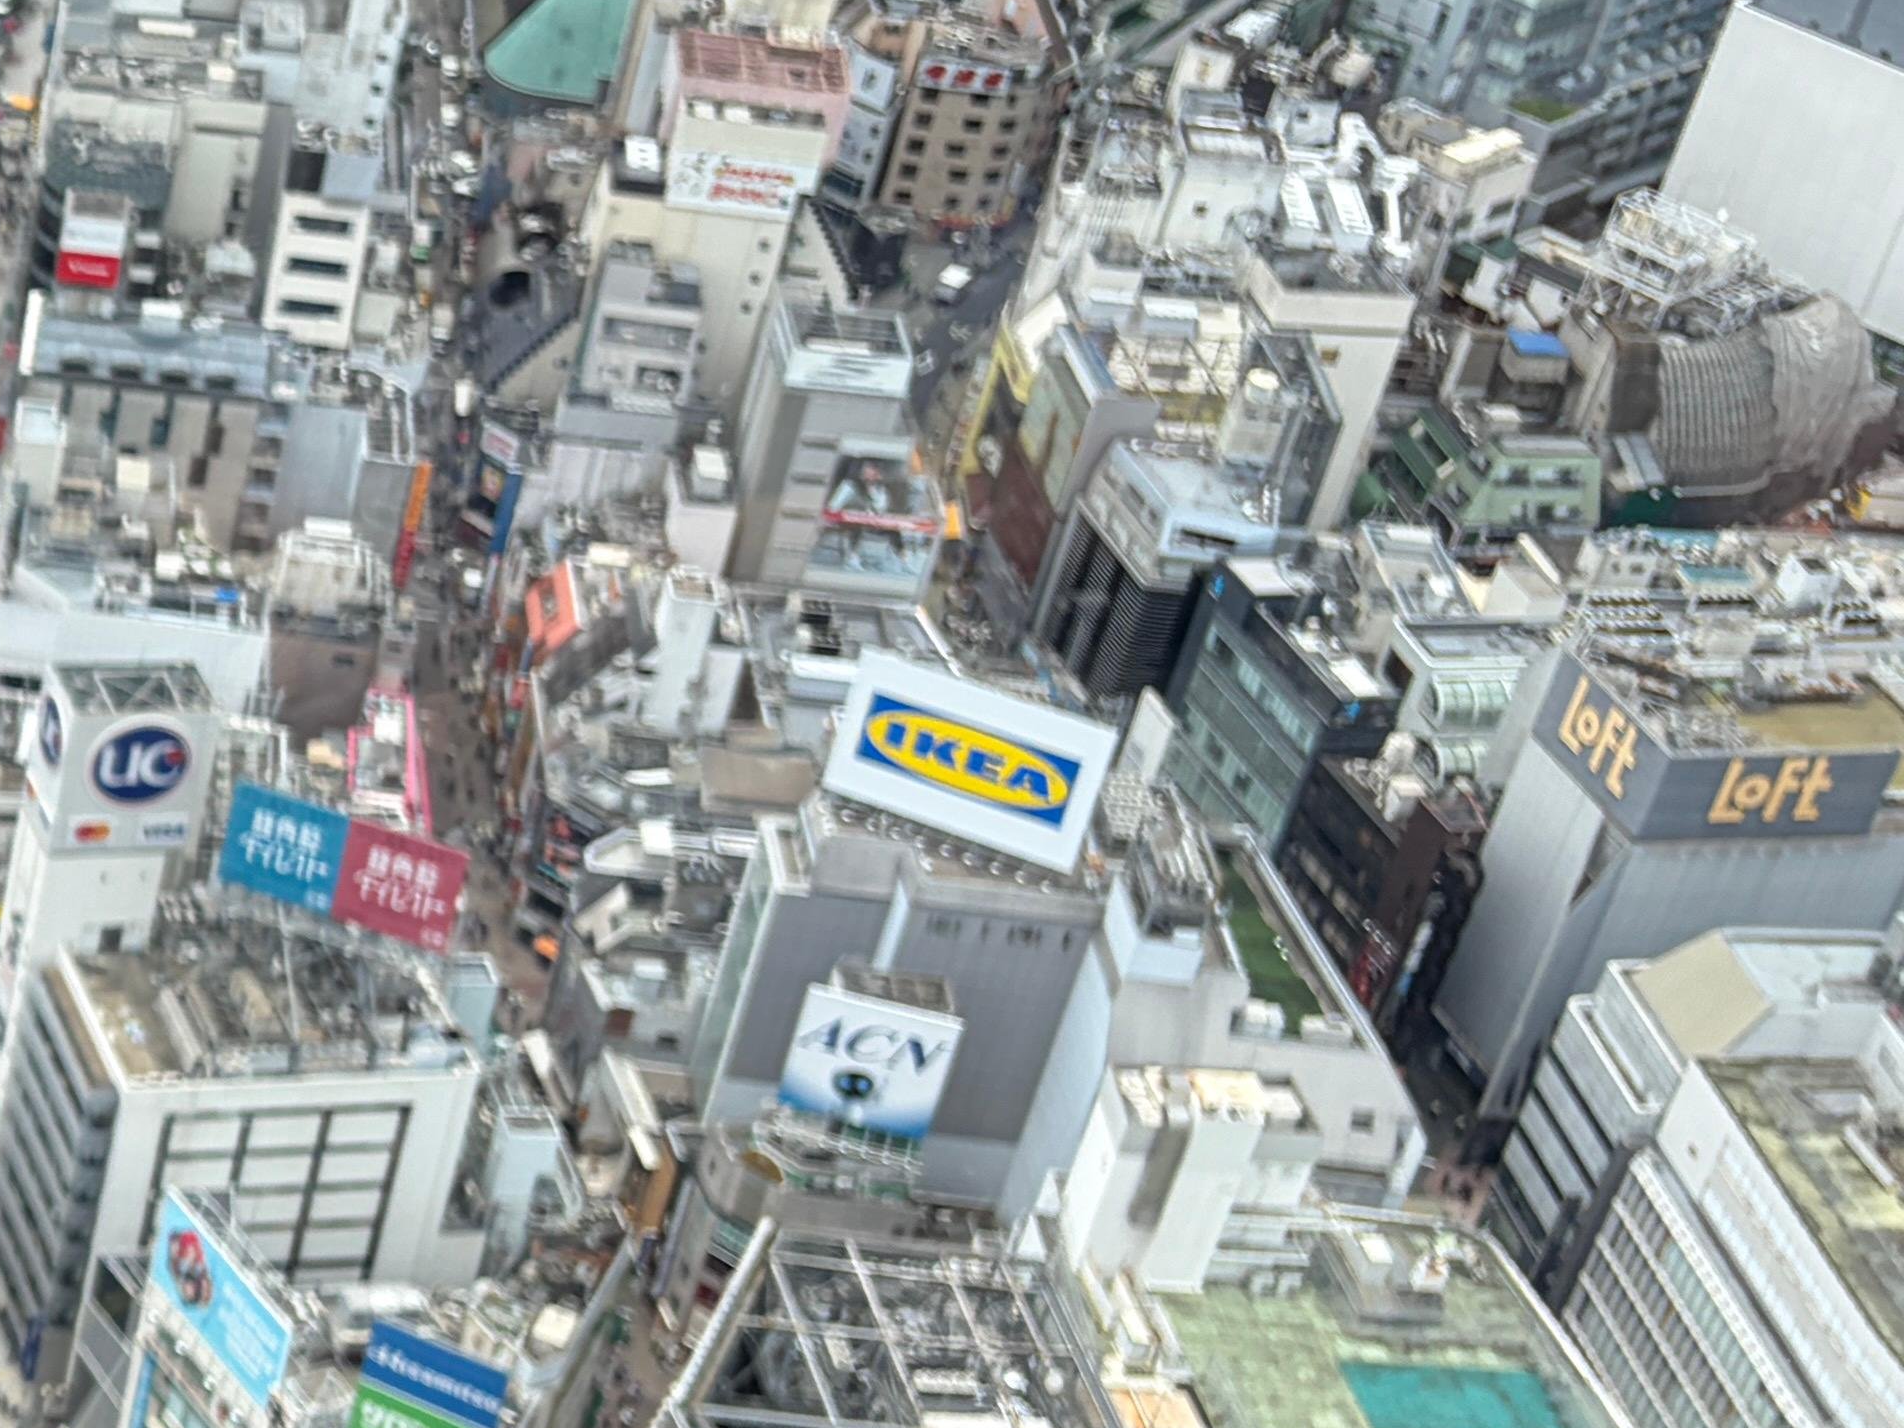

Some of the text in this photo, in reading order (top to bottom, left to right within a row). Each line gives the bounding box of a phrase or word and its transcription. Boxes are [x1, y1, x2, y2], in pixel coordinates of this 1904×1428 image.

[98, 738, 185, 788] UC
[884, 721, 1053, 805] IKEA
[797, 1016, 951, 1076] ACN
